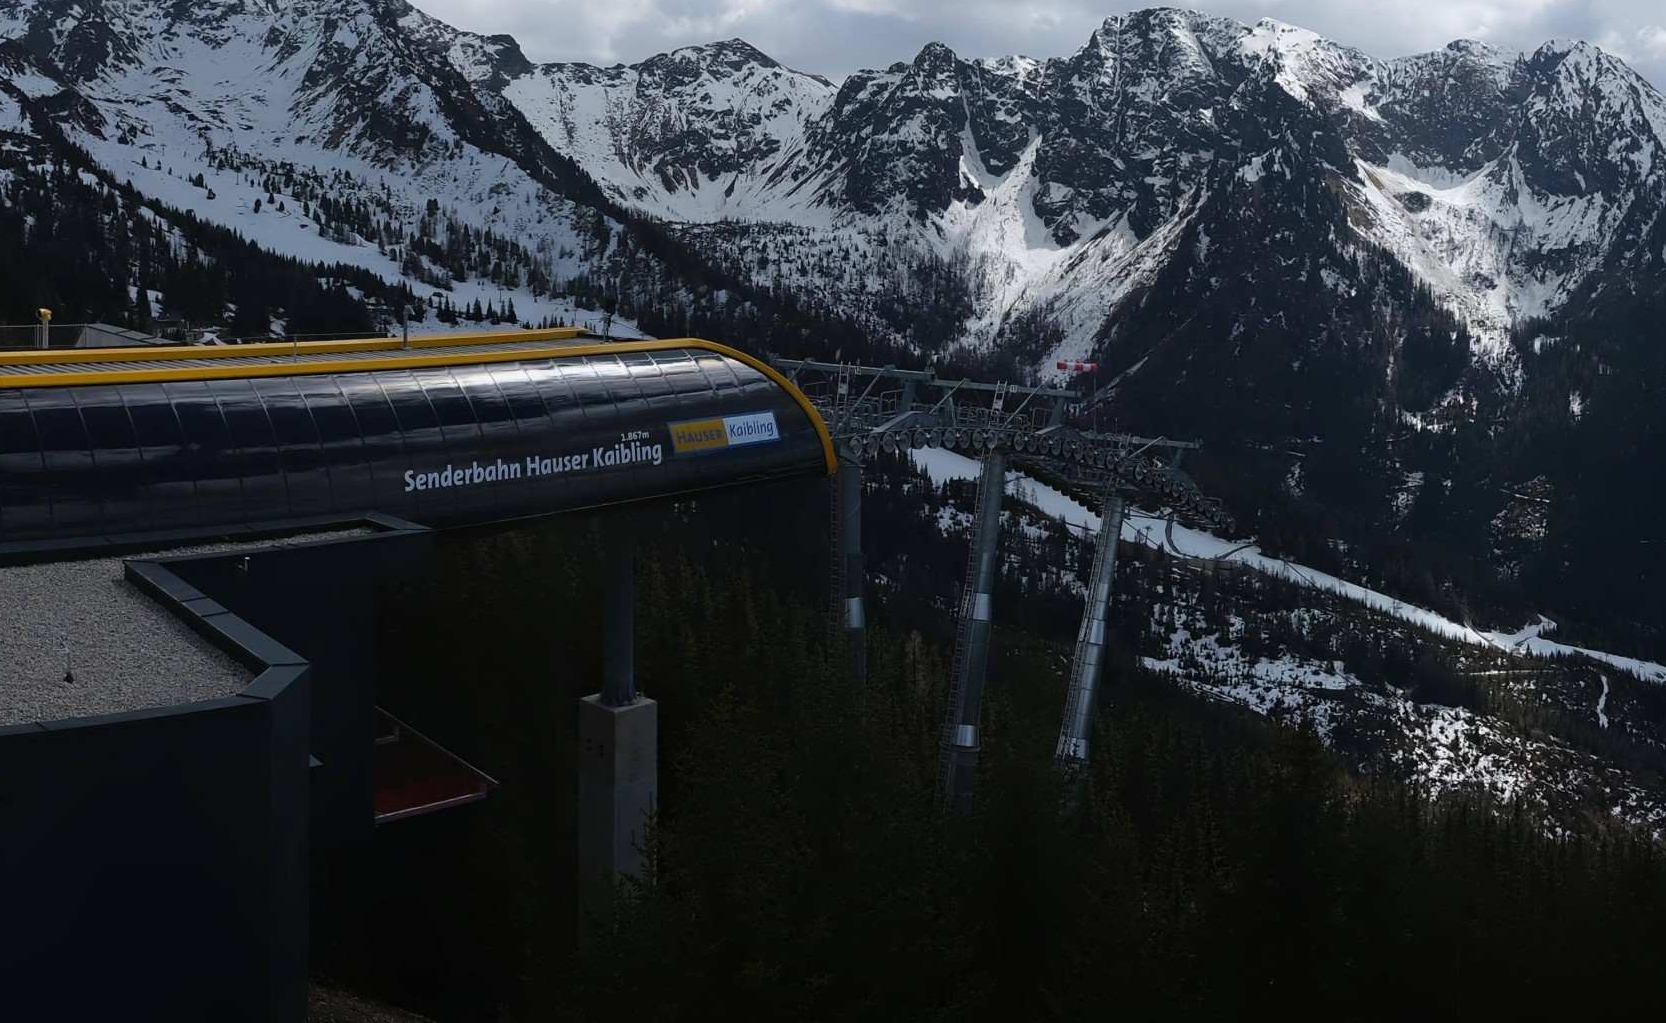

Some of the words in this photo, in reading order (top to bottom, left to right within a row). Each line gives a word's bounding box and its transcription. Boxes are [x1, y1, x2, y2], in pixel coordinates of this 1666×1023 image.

[621, 431, 649, 441] 1.867m
[676, 429, 723, 444] HAUSER
[728, 418, 775, 438] Kaibling
[404, 462, 521, 492] Senderbahn
[526, 453, 589, 477] Hauser
[593, 440, 662, 467] Kaibling
